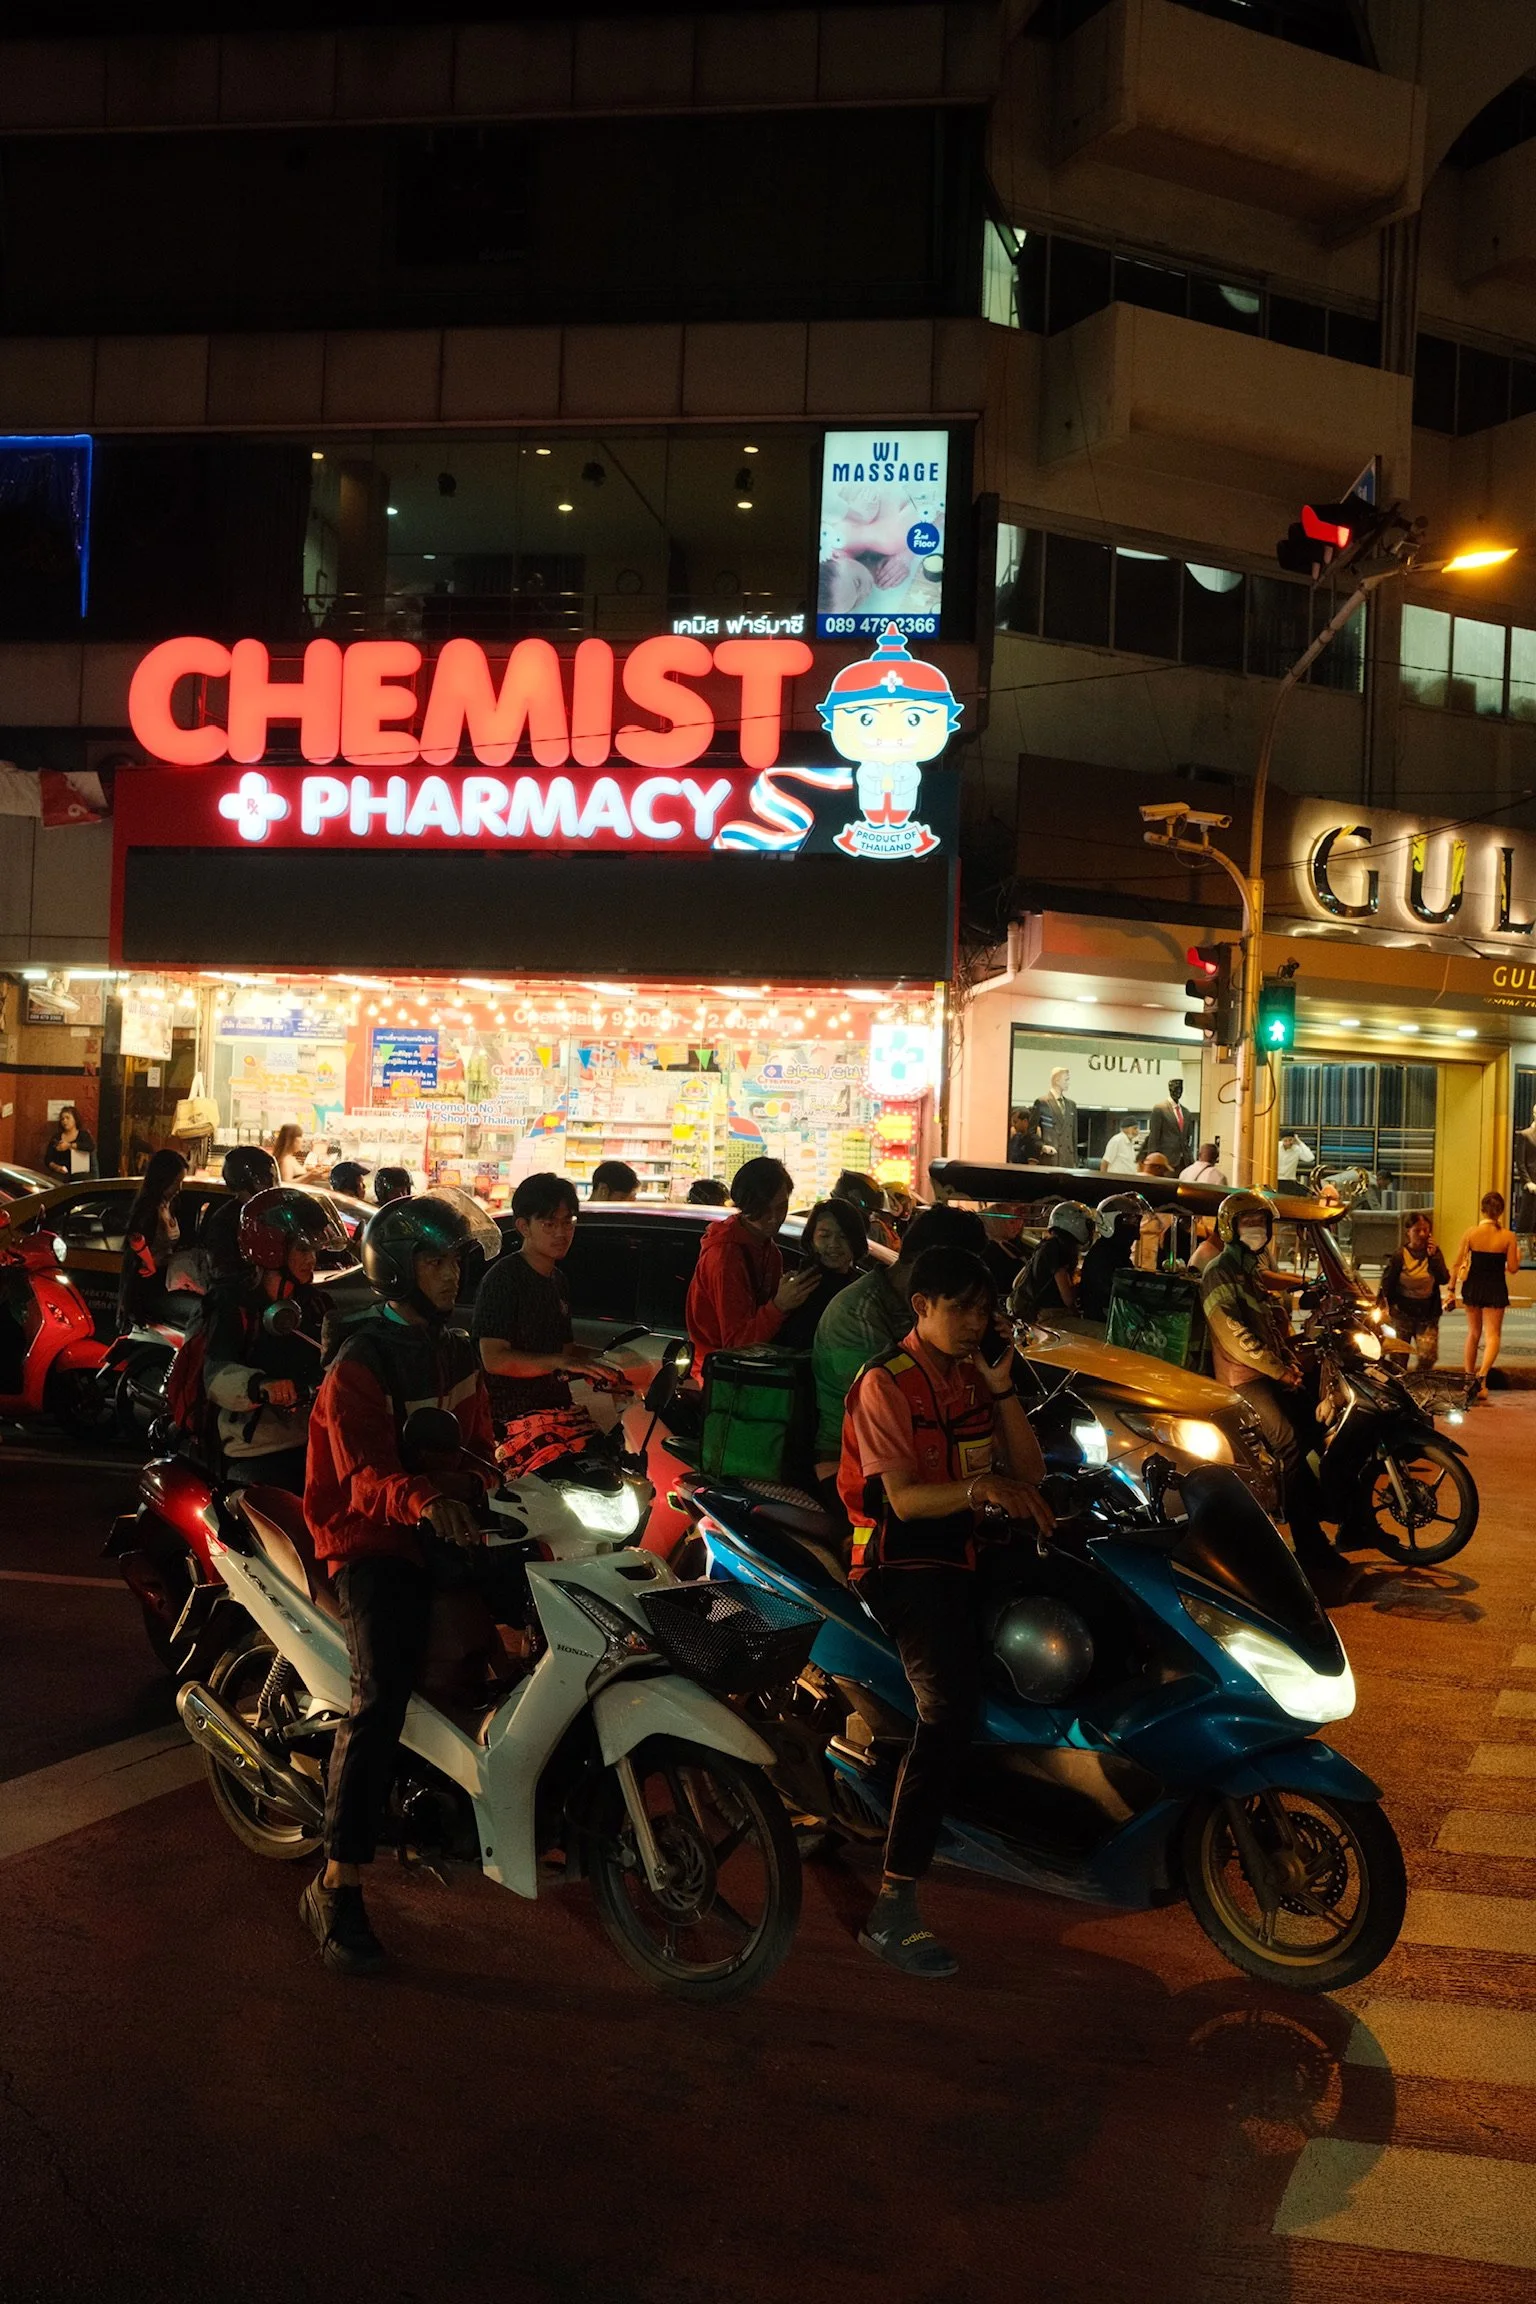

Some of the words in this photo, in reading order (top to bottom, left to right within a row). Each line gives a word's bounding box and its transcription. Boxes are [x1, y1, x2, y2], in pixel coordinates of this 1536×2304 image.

[872, 442, 899, 462] WI
[832, 463, 939, 482] MASSAGE
[913, 540, 937, 548] Floor
[825, 618, 856, 633] 089
[128, 636, 813, 769] CHEMIST
[300, 774, 731, 840] PHARMACY
[856, 830, 900, 843] PRODUCT
[904, 830, 917, 840] OF
[861, 842, 912, 852] THAILAND
[1308, 824, 1536, 935] GUL
[493, 1066, 542, 1077] CHEMIST
[1088, 1054, 1161, 1075] GULATI
[415, 1101, 463, 1112] Welcome
[466, 1103, 477, 1113] to
[440, 1113, 467, 1125] Shop
[469, 1115, 479, 1124] in
[482, 1115, 527, 1126] Thailand
[557, 1644, 594, 1659] HONDA
